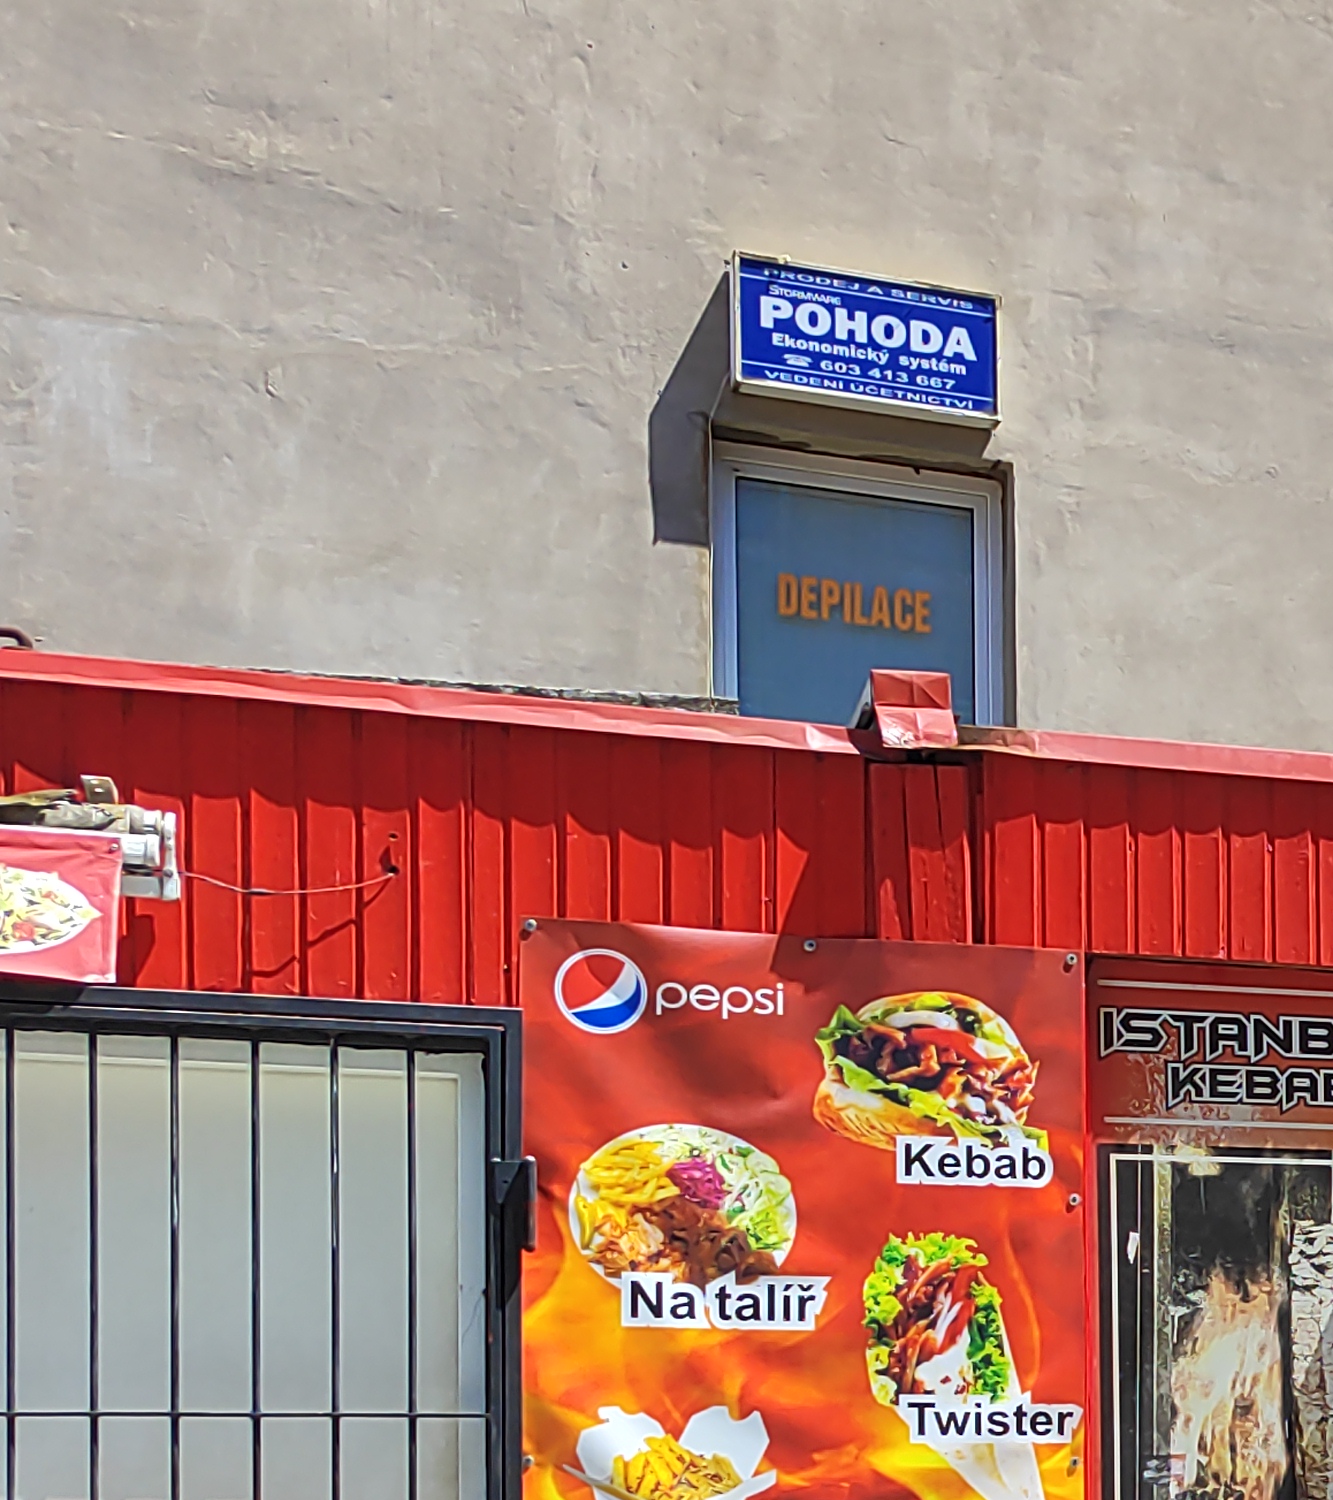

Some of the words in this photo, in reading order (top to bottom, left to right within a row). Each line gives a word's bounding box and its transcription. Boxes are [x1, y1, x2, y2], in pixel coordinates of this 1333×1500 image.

[764, 268, 860, 290] PRODEJ
[867, 285, 884, 295] A
[891, 288, 973, 310] SERVIS
[759, 295, 977, 362] POHODA
[771, 332, 890, 365] Ekonomický
[898, 354, 967, 375] systém
[820, 361, 861, 376] 603
[867, 367, 909, 384] 413
[915, 374, 956, 390] 667
[776, 571, 932, 634] DEPILACE
[654, 980, 785, 1019] pepsi
[902, 1143, 1048, 1180] Kebab
[628, 1280, 698, 1321] Na
[715, 1279, 818, 1323] talíř
[907, 1401, 1075, 1437] Twister
